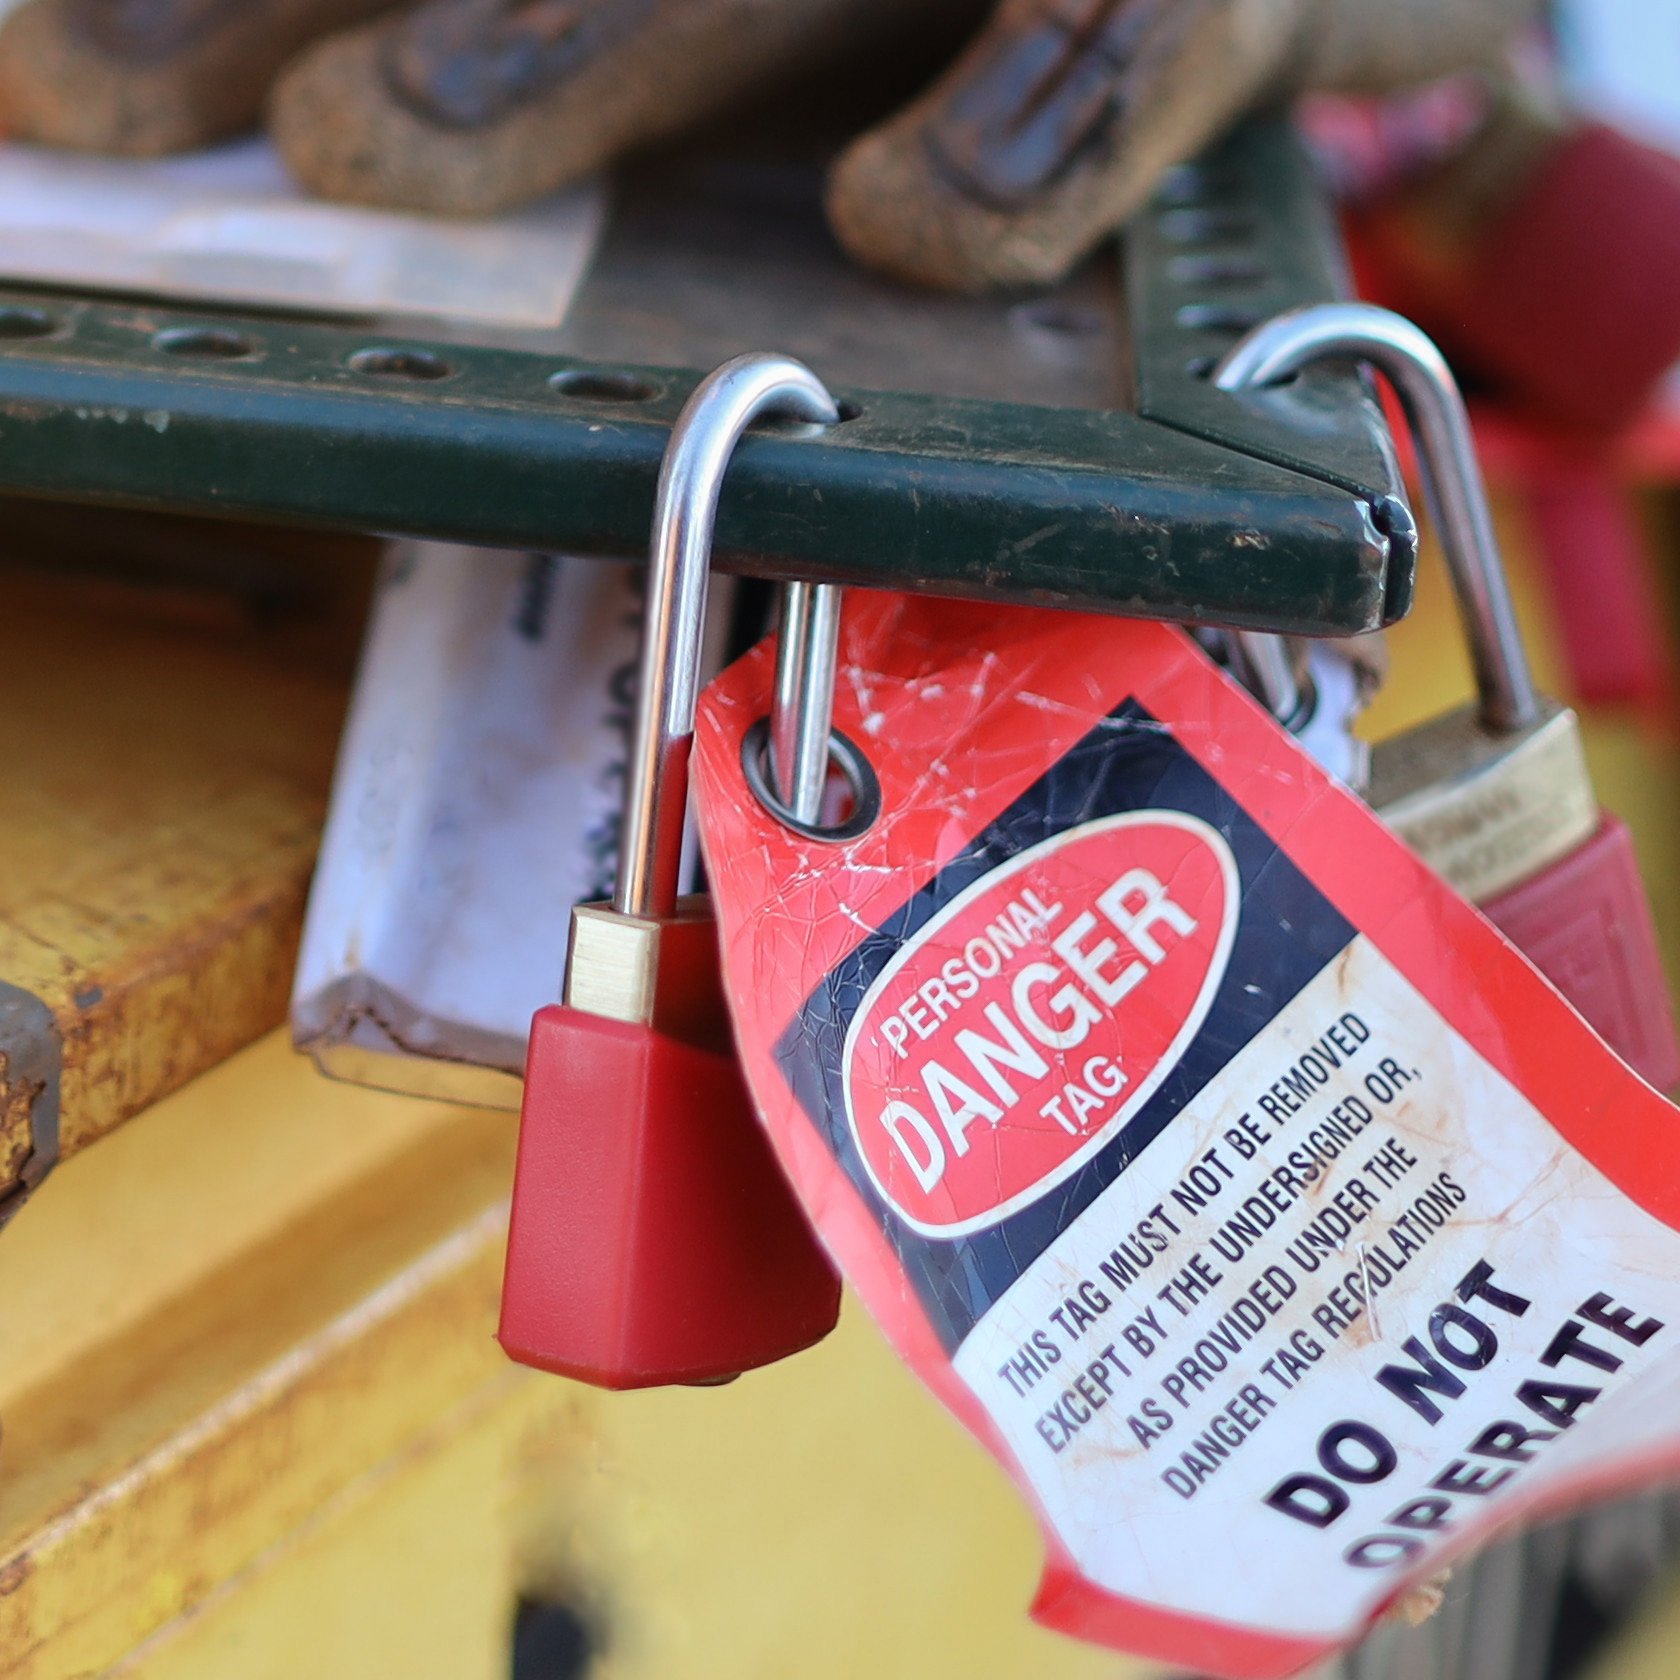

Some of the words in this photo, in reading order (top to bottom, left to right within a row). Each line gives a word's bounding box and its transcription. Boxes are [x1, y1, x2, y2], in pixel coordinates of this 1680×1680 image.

[879, 888, 1065, 1060] PERSONAL
[879, 867, 1200, 1195] DANGER
[1039, 1055, 1130, 1136] TAG
[997, 1329, 1062, 1399] THIS
[1048, 1280, 1114, 1341] TAG
[1098, 1203, 1182, 1293] MUST
[1169, 1147, 1235, 1217] NOT
[1223, 1113, 1272, 1161] BE
[1257, 1011, 1370, 1126] REMOVED
[1034, 1343, 1133, 1455] EXCEPT
[1121, 1304, 1169, 1359] BY
[1156, 1252, 1224, 1317] THE
[1208, 1095, 1374, 1263] UNDERSIGNED
[1364, 1056, 1423, 1105] OR,
[1125, 1396, 1175, 1450] AS
[1160, 1264, 1298, 1409] PROVIDED
[1285, 1178, 1382, 1272] UNDER
[1363, 1136, 1419, 1190] THE
[1159, 1382, 1277, 1501] DANGER
[1259, 1328, 1326, 1390] TAG
[1311, 1171, 1467, 1339] REGULATIONS
[1261, 1418, 1398, 1530] DO
[1374, 1257, 1532, 1427] NOT
[1342, 1290, 1667, 1569] OPERATE
